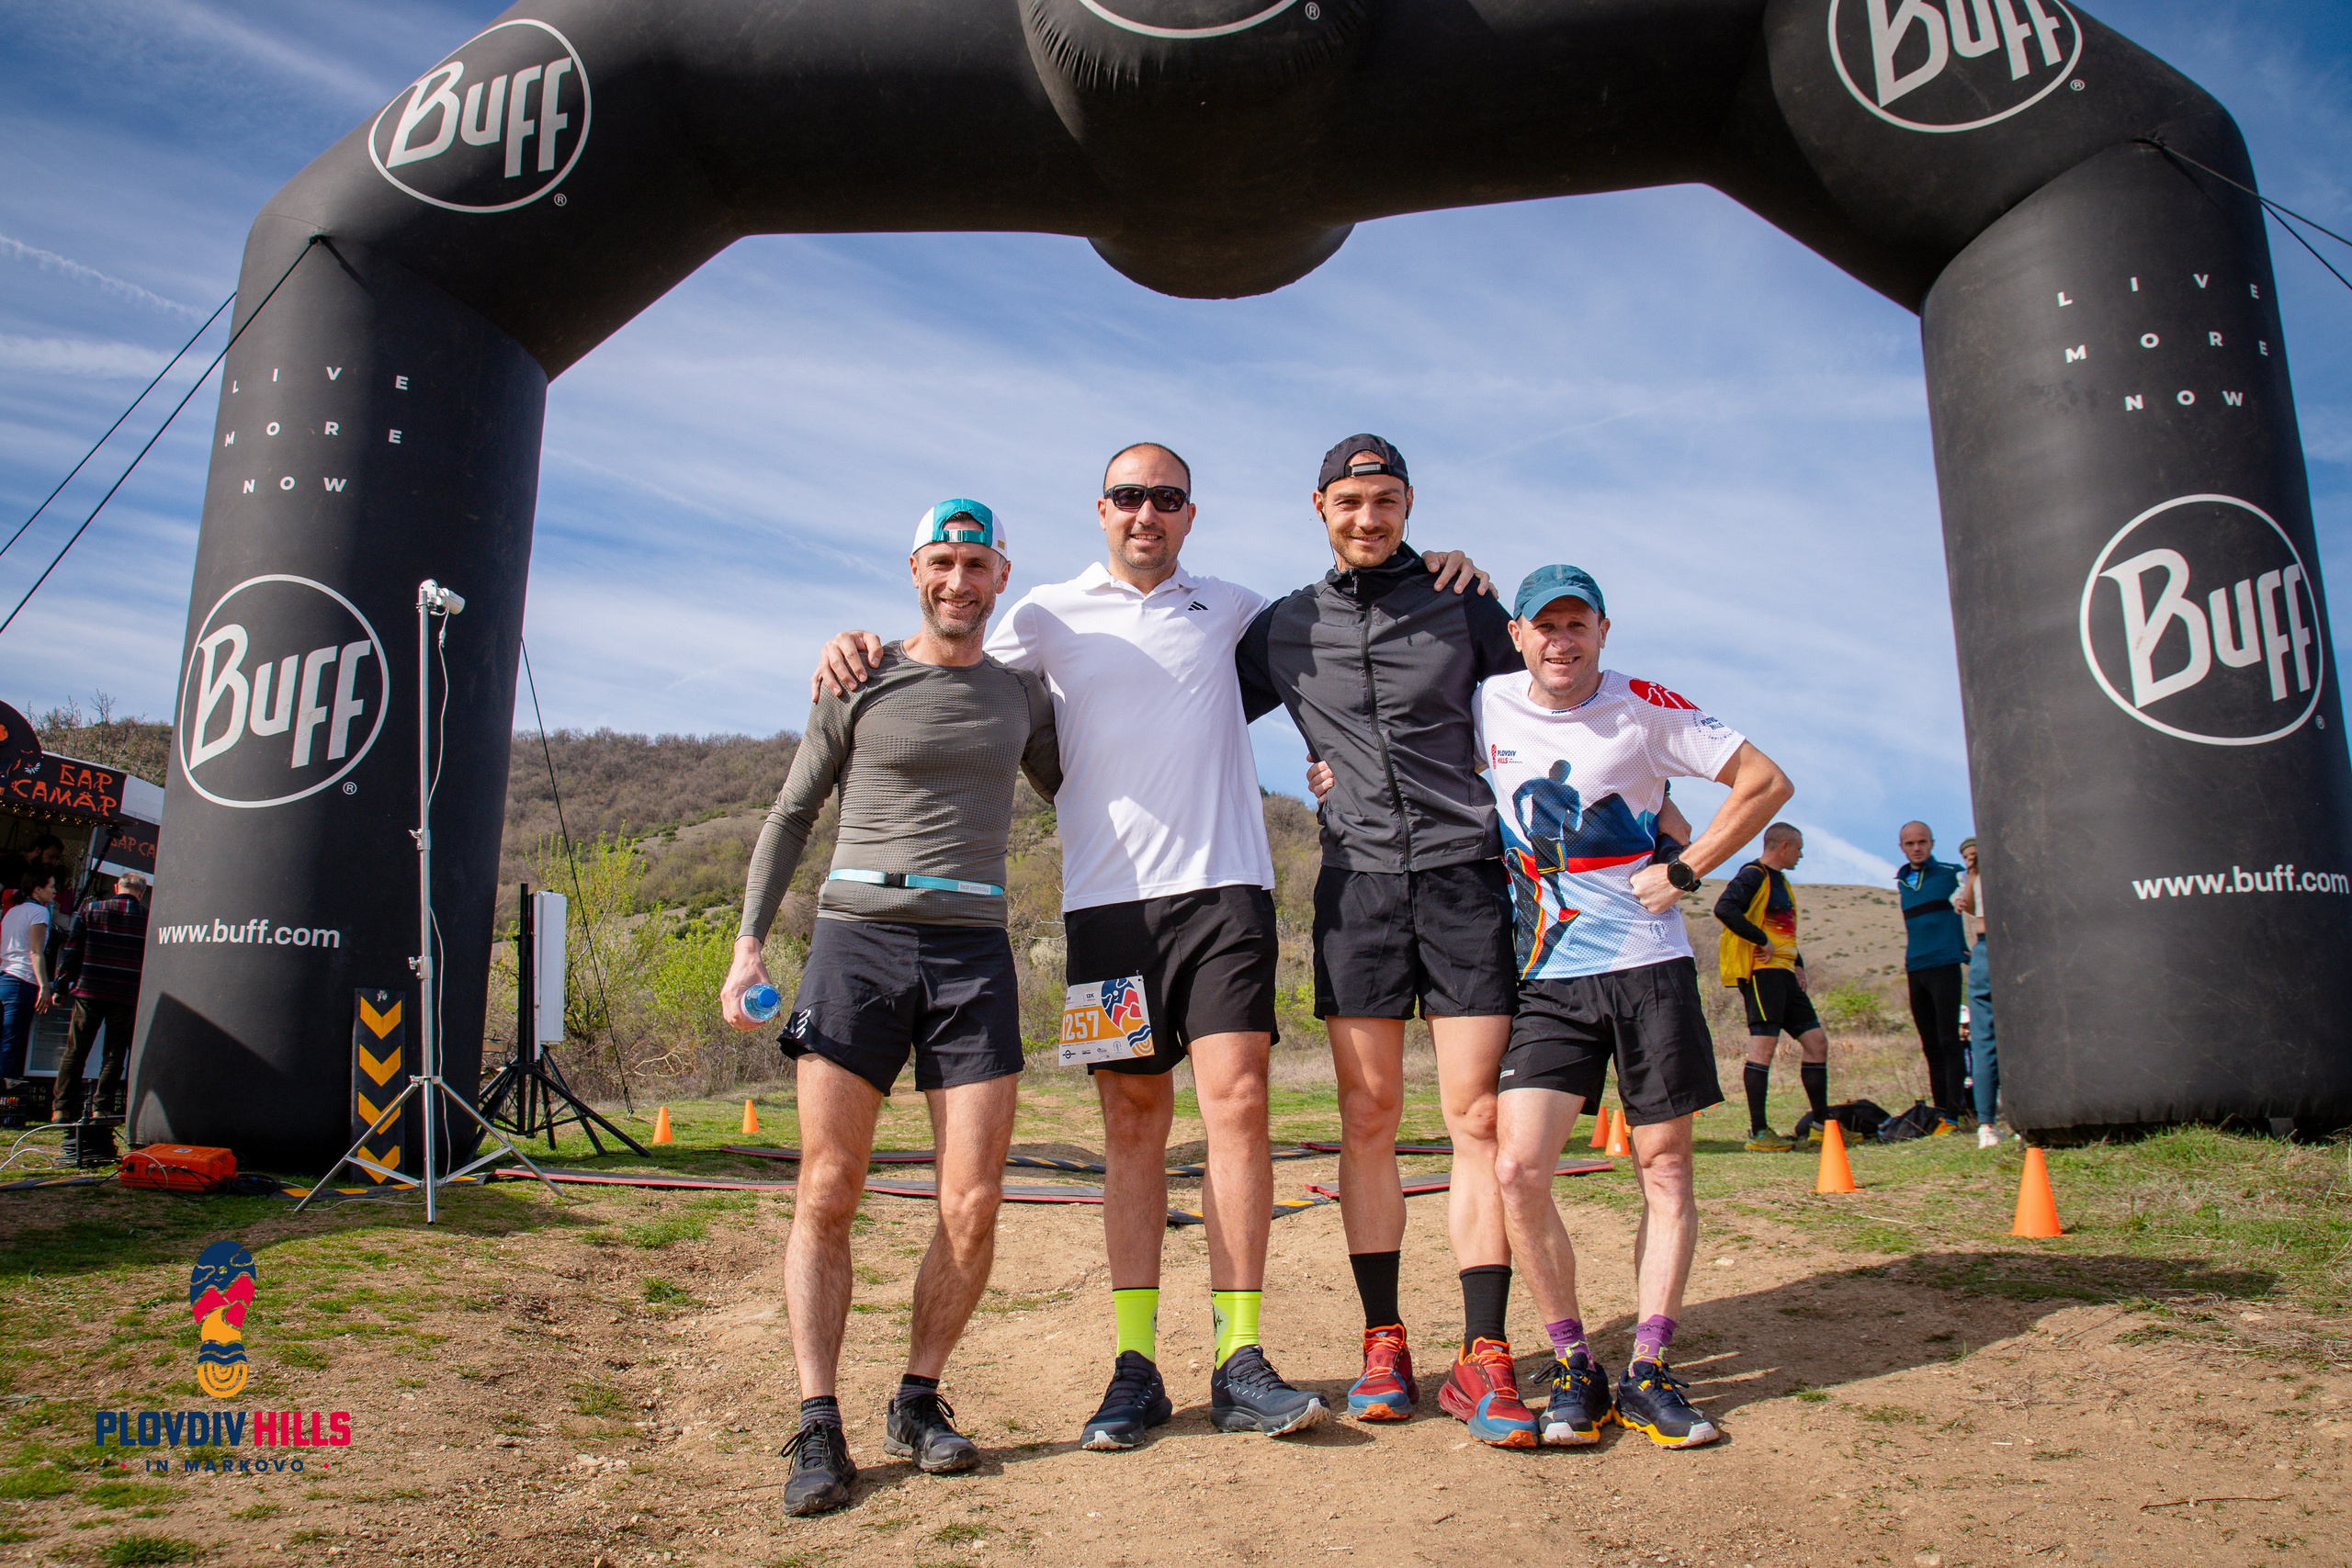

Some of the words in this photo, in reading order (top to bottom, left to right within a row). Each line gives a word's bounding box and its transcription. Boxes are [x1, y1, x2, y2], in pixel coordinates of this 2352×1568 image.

[2057, 274, 2259, 307] LIVE
[2065, 331, 2268, 363] MORE
[232, 367, 409, 394] LIVE
[2124, 389, 2244, 411] NOW
[224, 421, 402, 446] MORE
[243, 476, 347, 494] NOW
[60, 764, 113, 793] БАР
[2132, 863, 2350, 899] www.buff.com
[158, 919, 341, 948] www.buff.com
[1062, 1010, 1099, 1042] 1257
